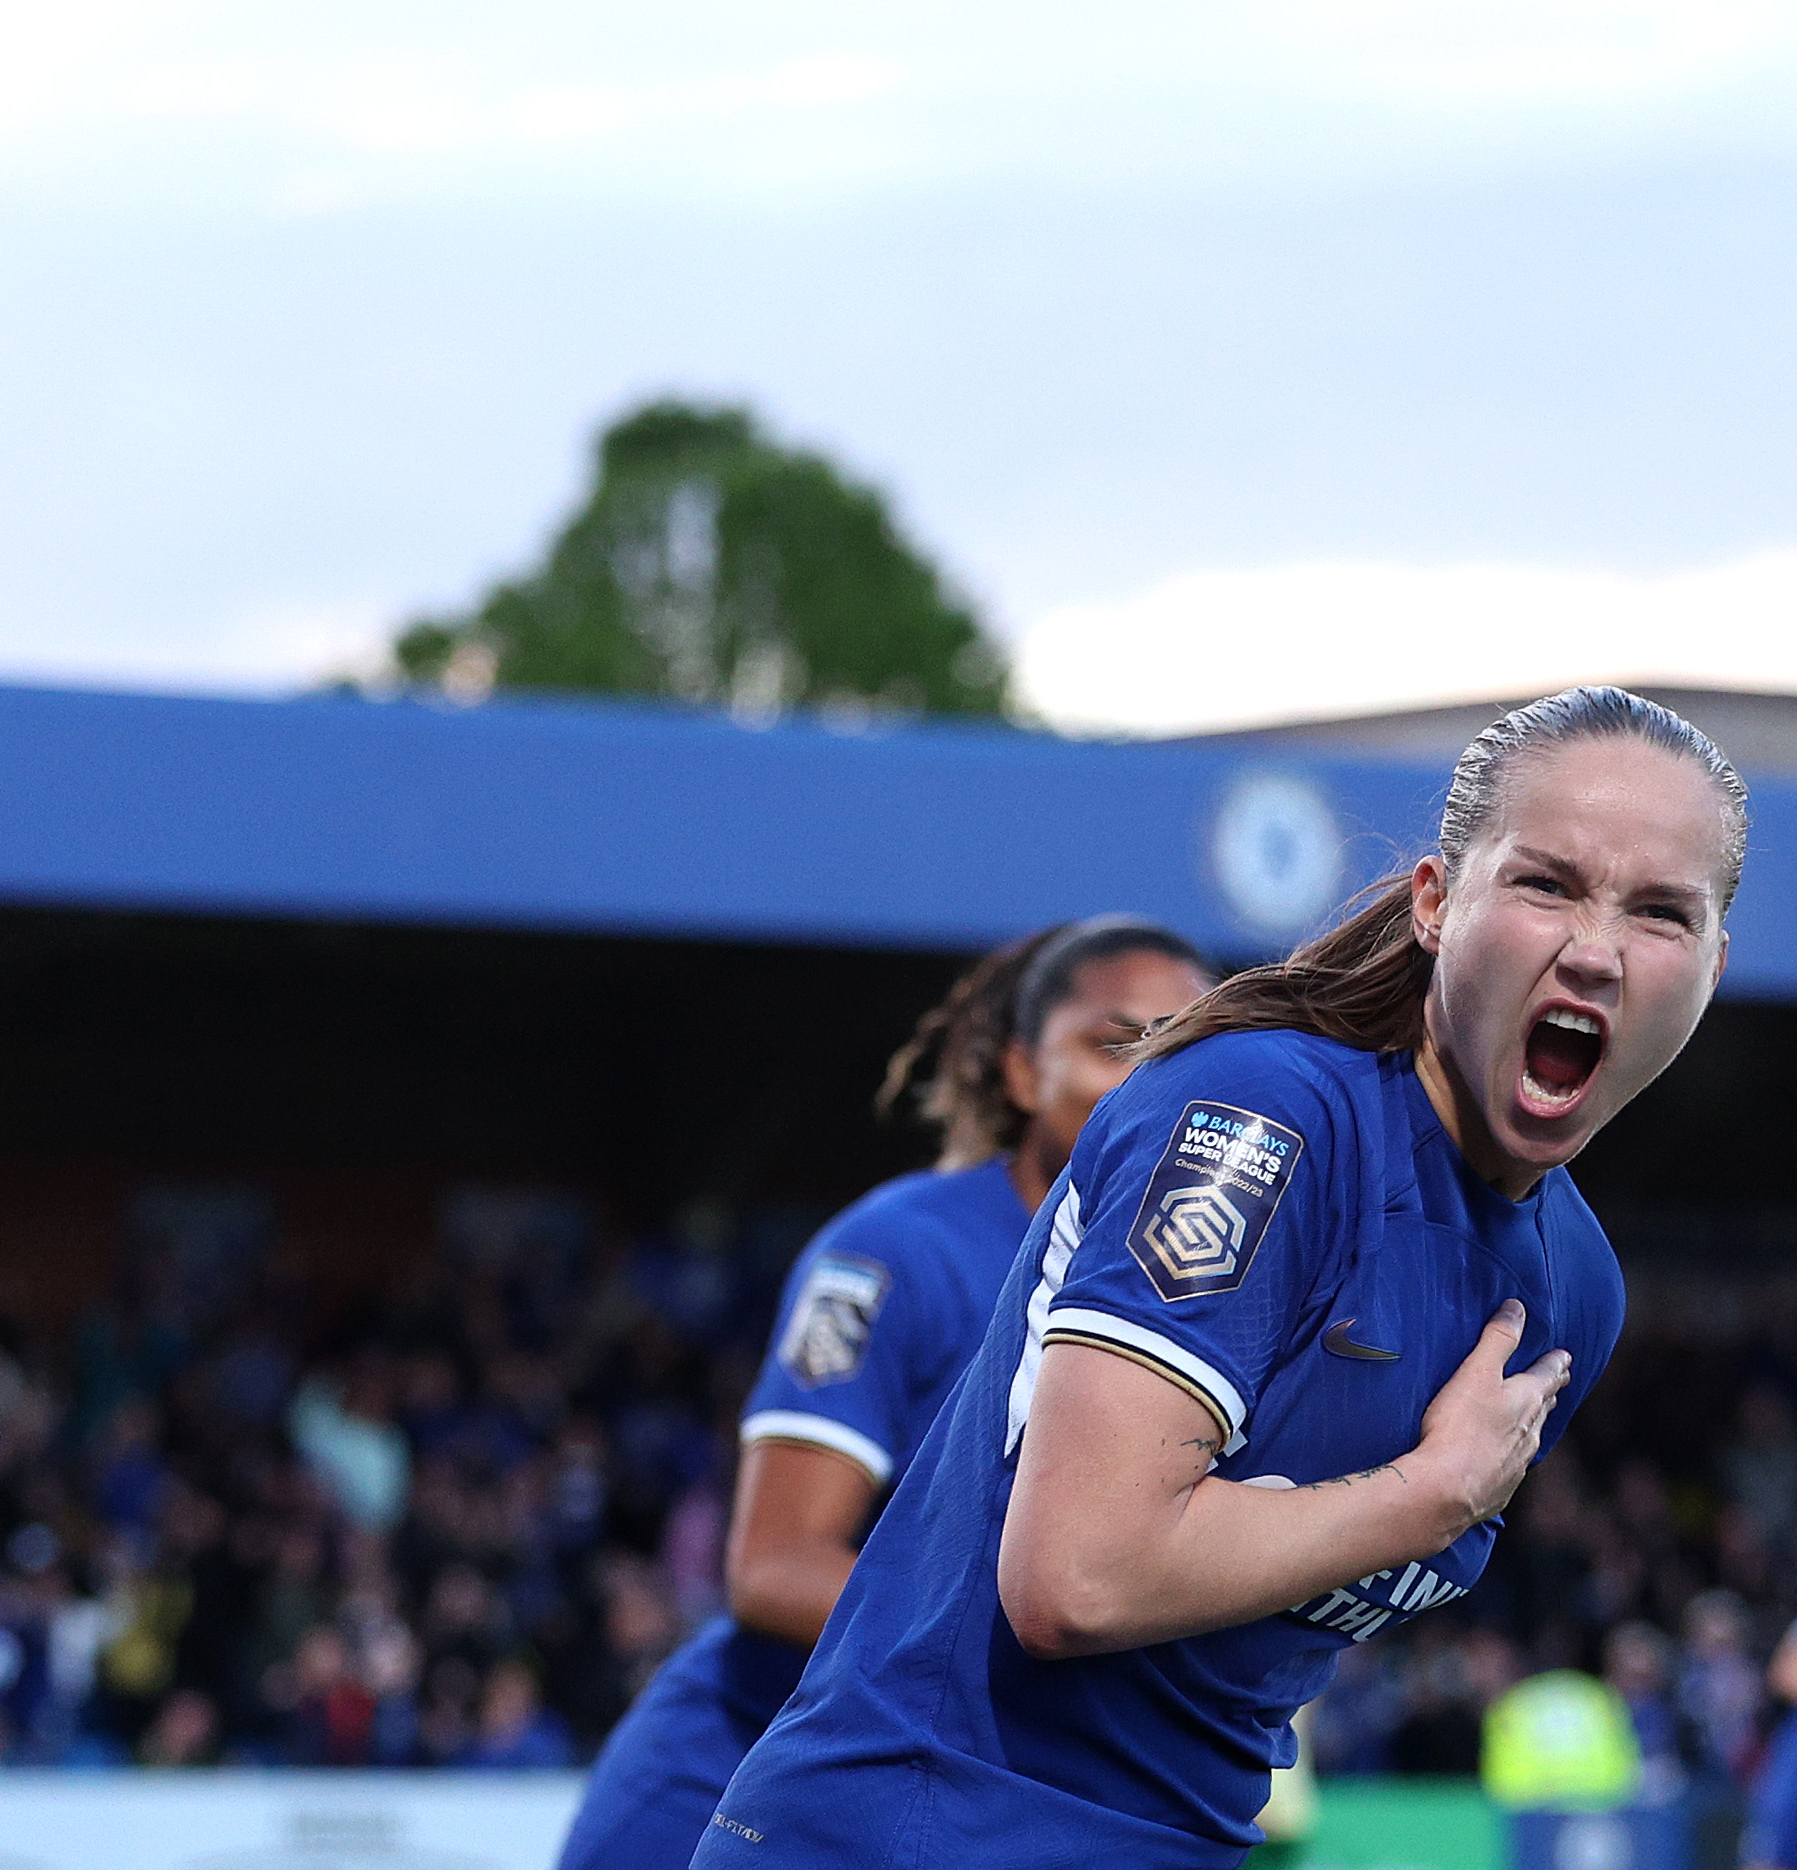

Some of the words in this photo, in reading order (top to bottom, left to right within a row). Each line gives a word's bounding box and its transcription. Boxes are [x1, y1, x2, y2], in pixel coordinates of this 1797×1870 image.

[1185, 1127, 1282, 1173] WOMEN'S
[1208, 1116, 1289, 1157] BARCLAYS
[1178, 1142, 1222, 1162] SUPER
[1222, 1153, 1276, 1186] LEAGUE
